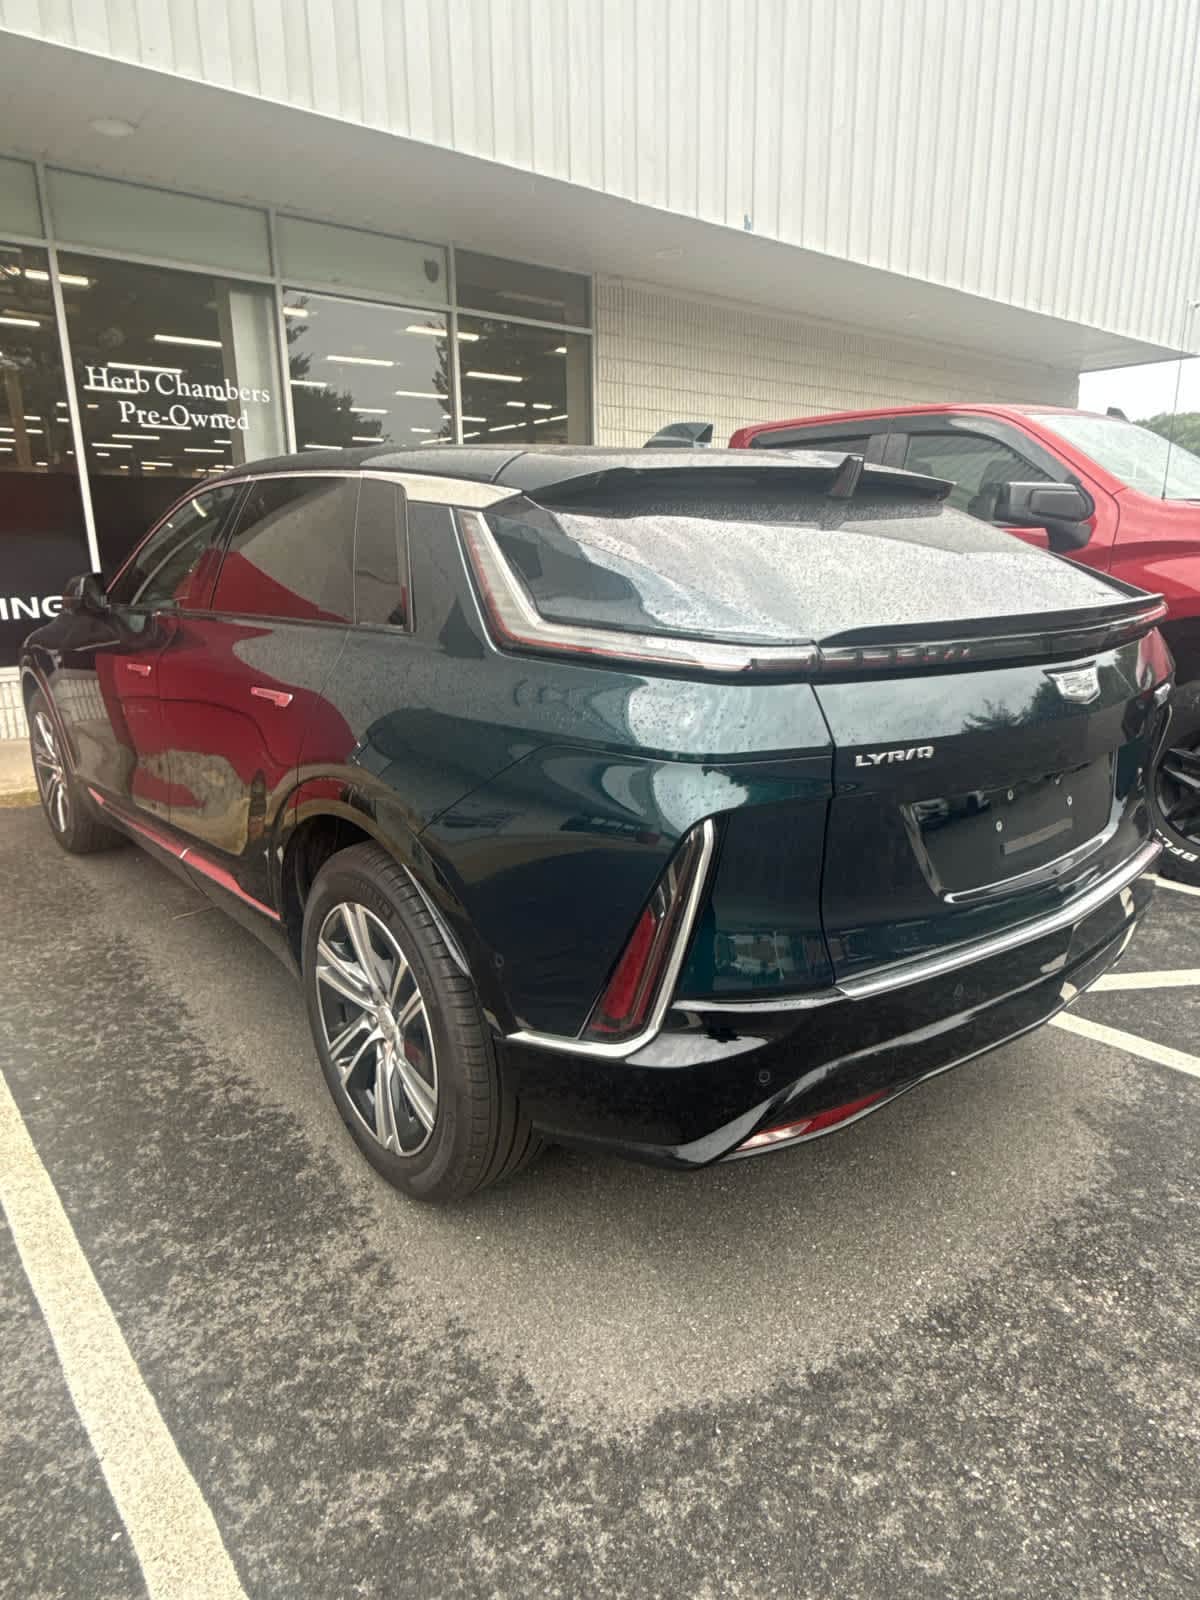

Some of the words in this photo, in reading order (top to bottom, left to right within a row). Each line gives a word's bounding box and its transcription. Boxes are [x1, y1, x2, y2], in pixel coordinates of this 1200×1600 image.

[85, 366, 150, 393] Herb
[155, 373, 271, 403] Chambers
[117, 400, 250, 430] Pre-Owned
[855, 745, 935, 768] LYRIQ
